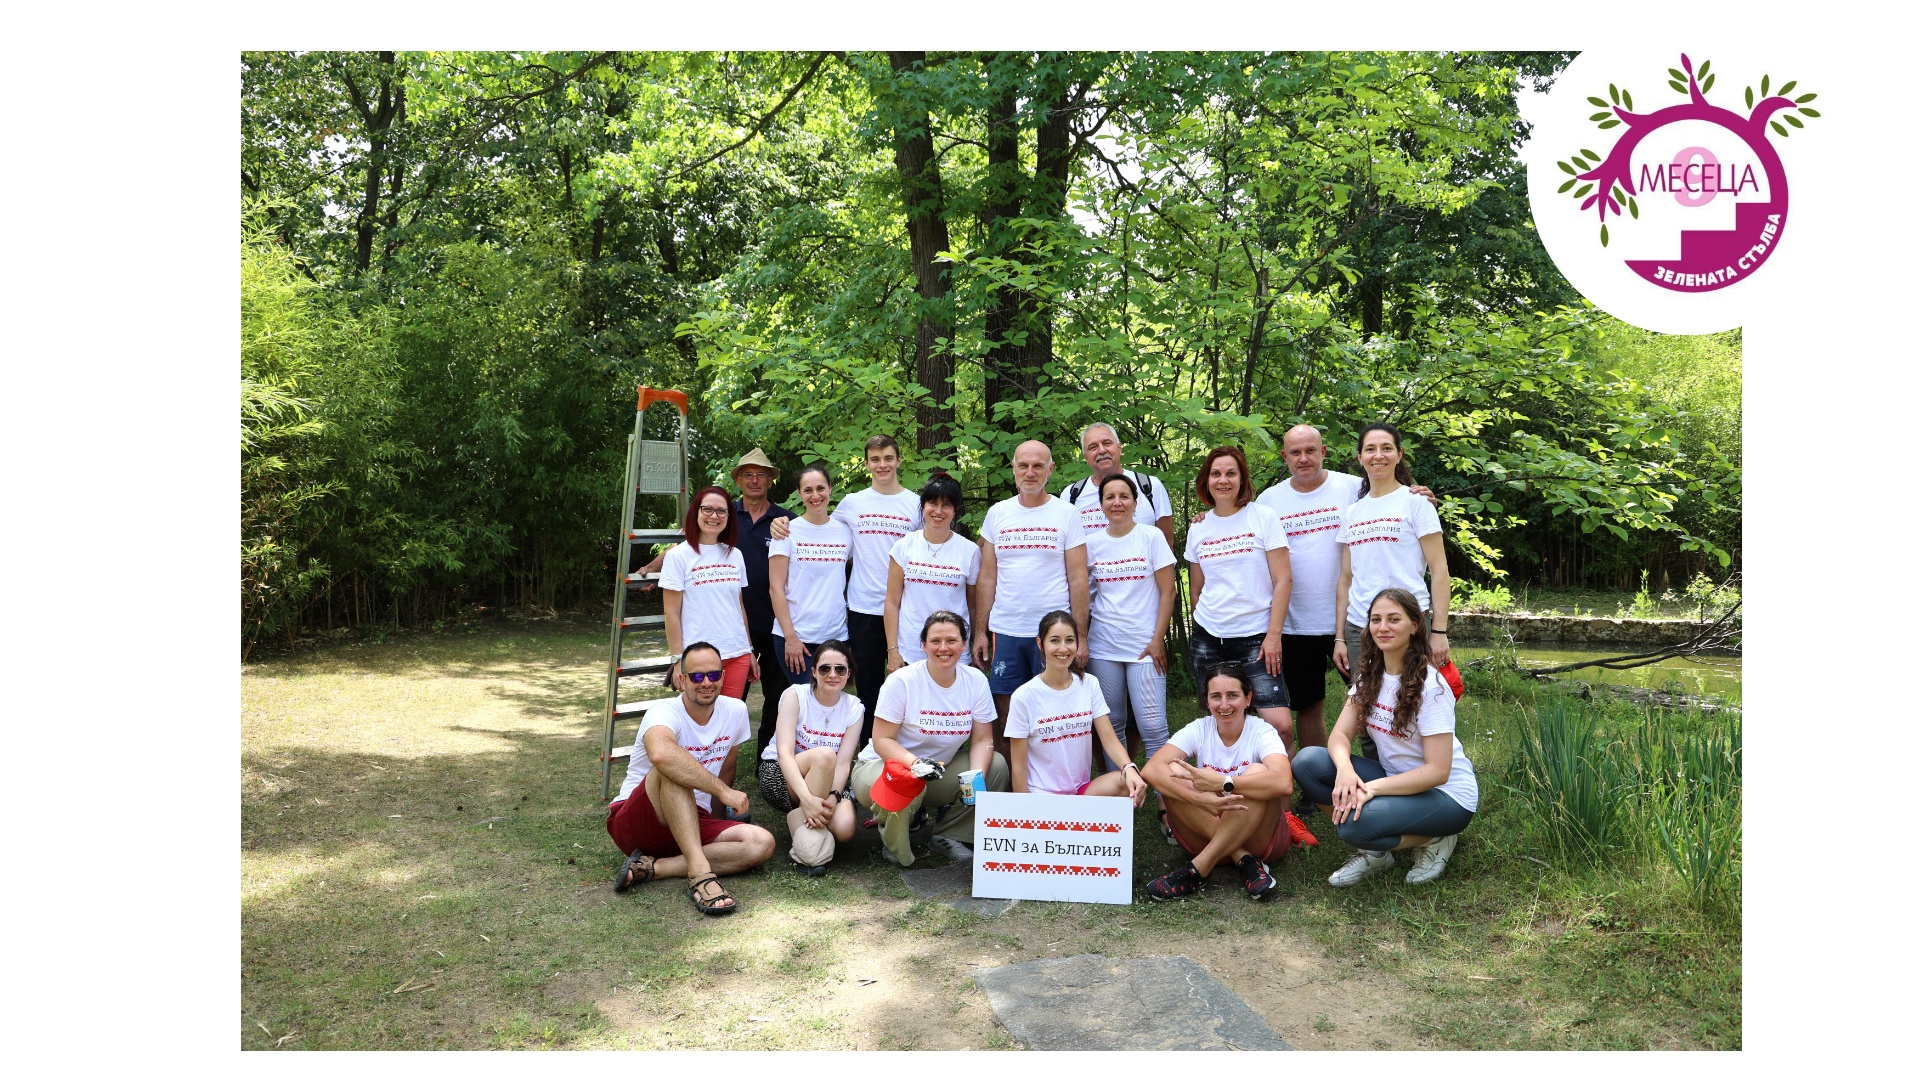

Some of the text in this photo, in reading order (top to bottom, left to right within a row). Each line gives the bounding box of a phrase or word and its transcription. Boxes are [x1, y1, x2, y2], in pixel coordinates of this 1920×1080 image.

[919, 718, 935, 726] EVN
[1038, 725, 1055, 735] EVN
[983, 837, 1121, 857] EVN за България
